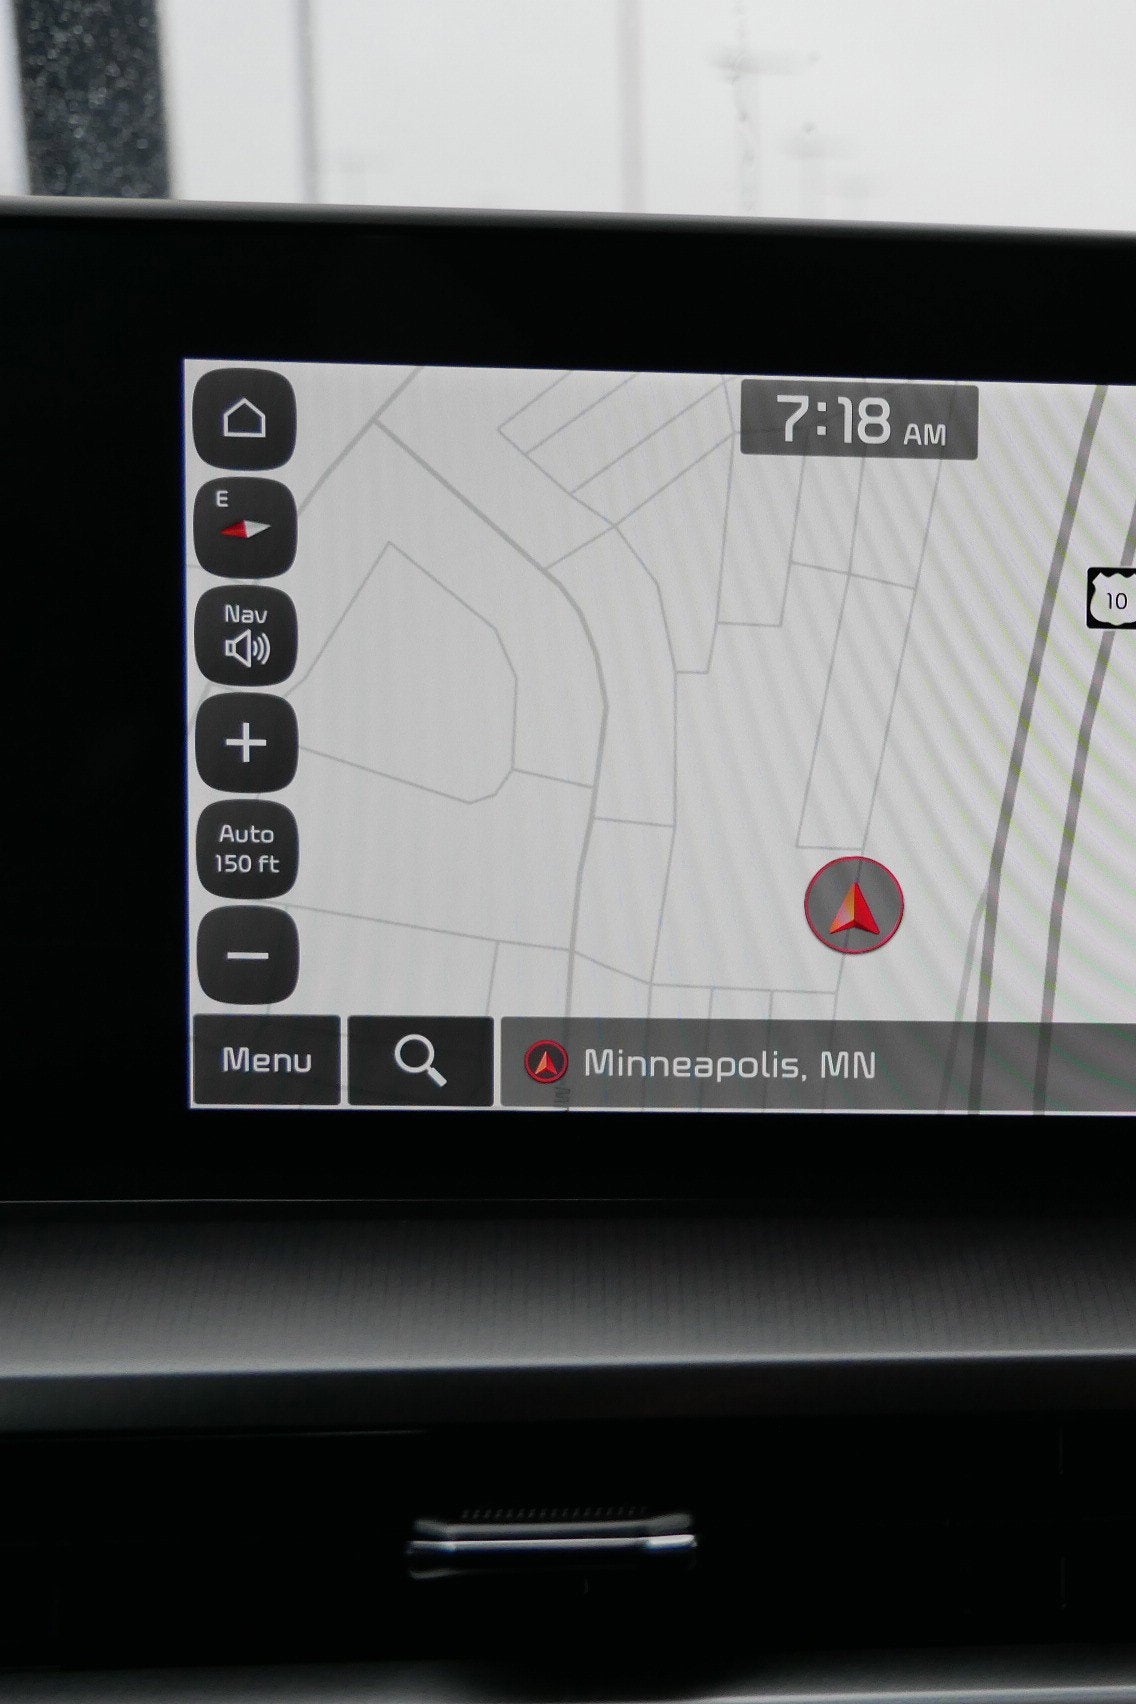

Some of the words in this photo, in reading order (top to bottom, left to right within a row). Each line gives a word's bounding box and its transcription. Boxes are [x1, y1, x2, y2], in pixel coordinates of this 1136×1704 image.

[776, 394, 892, 444] 7:18
[903, 422, 947, 446] AM
[215, 491, 228, 507] E
[1106, 592, 1128, 610] 10
[224, 604, 268, 624] Nav
[219, 825, 274, 844] Auto
[215, 854, 253, 873] 150
[257, 854, 280, 873] ft
[221, 1047, 312, 1074] Menu
[584, 1049, 808, 1085] Minneapolis,
[820, 1052, 876, 1080] MN
